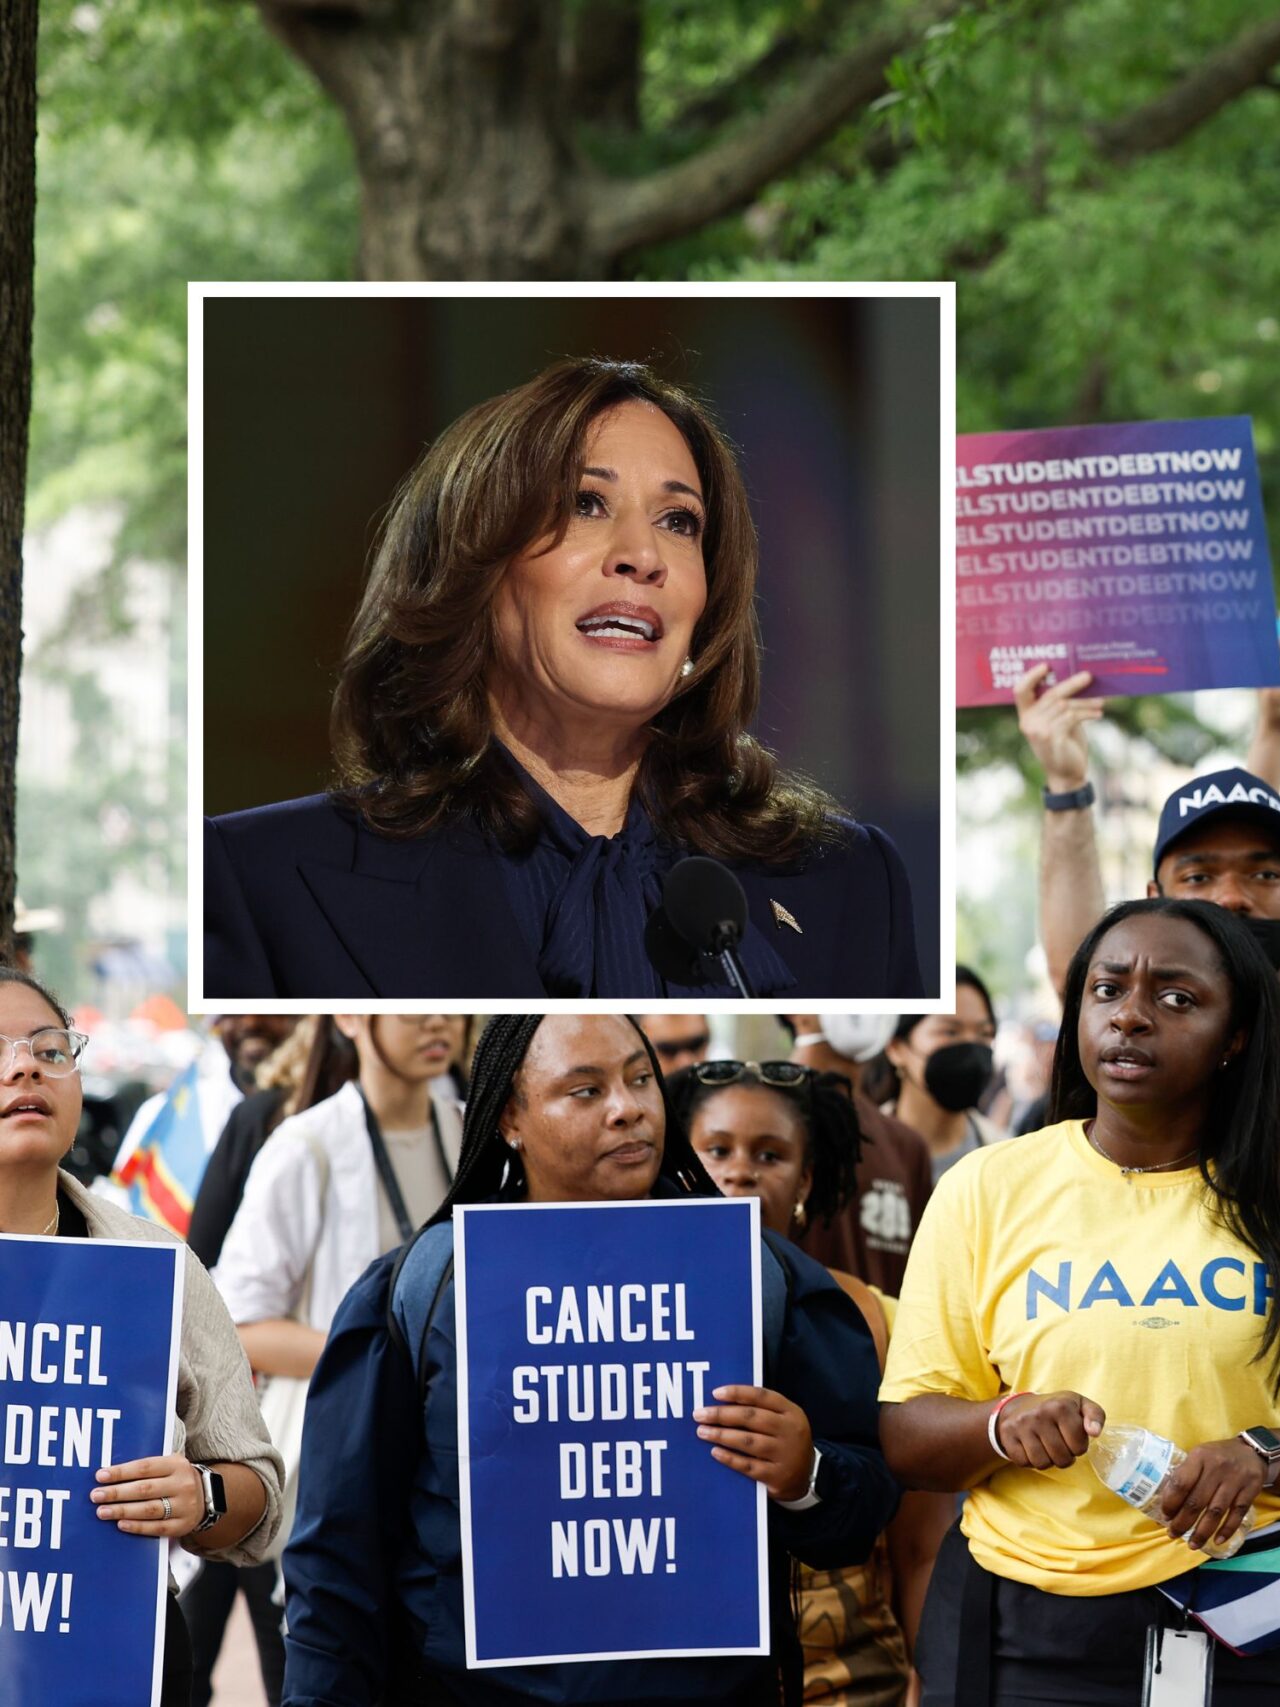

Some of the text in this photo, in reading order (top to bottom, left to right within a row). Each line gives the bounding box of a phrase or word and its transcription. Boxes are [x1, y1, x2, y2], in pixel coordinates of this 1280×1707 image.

[956, 569, 1257, 607] ELSTUDENTDEBTNOW
[989, 643, 1067, 660] ALLIANCE
[991, 659, 1025, 674] FOR
[525, 1282, 695, 1345] CANCEL
[511, 1360, 710, 1424] STUDENT
[559, 1439, 668, 1500] DEBT
[551, 1517, 677, 1579] NOW!
